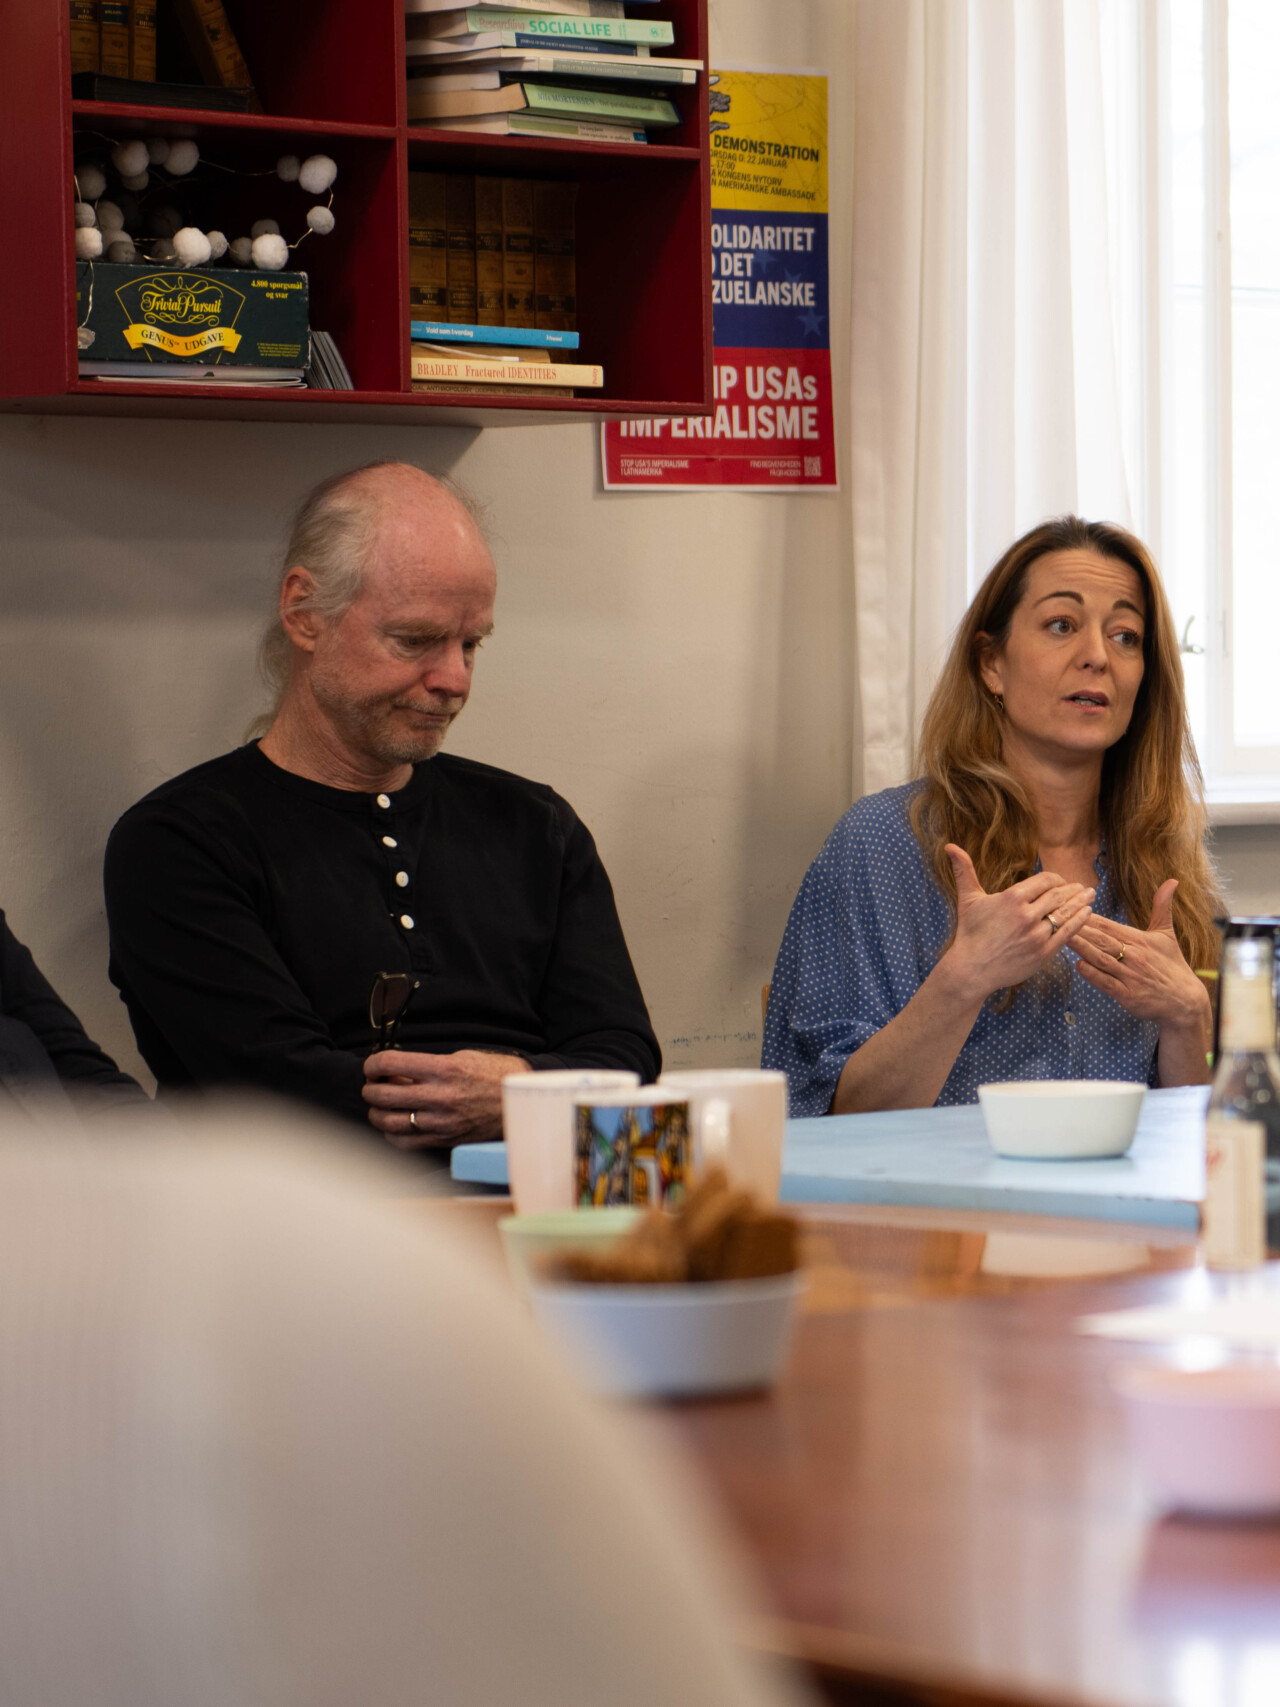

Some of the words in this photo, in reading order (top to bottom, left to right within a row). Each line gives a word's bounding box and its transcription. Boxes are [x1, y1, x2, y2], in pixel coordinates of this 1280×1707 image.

[529, 20, 581, 36] SOCIAL
[583, 22, 612, 37] LIFE
[714, 134, 820, 163] DEMONSTRATION
[747, 155, 756, 164] 22
[757, 157, 788, 169] JANUAR
[717, 169, 751, 182] KONGENS
[752, 175, 783, 186] NYTORV
[718, 179, 769, 195] AMERIKANSKE
[770, 186, 817, 202] AMBASSADE
[720, 252, 754, 277] DET
[265, 292, 275, 300] og
[712, 279, 816, 306] ZUELANSKE
[140, 291, 183, 312] Trivial
[177, 291, 222, 318] Pursuit
[184, 332, 225, 351] UDGAVE
[417, 362, 458, 377] BRADLEY
[465, 364, 505, 379] Fractured
[508, 366, 557, 380] IDENTITIES
[745, 366, 818, 400] USAs
[620, 458, 634, 468] STOP
[651, 459, 689, 469] IMPERIALISME
[624, 467, 663, 477] LATINAMERIKA
